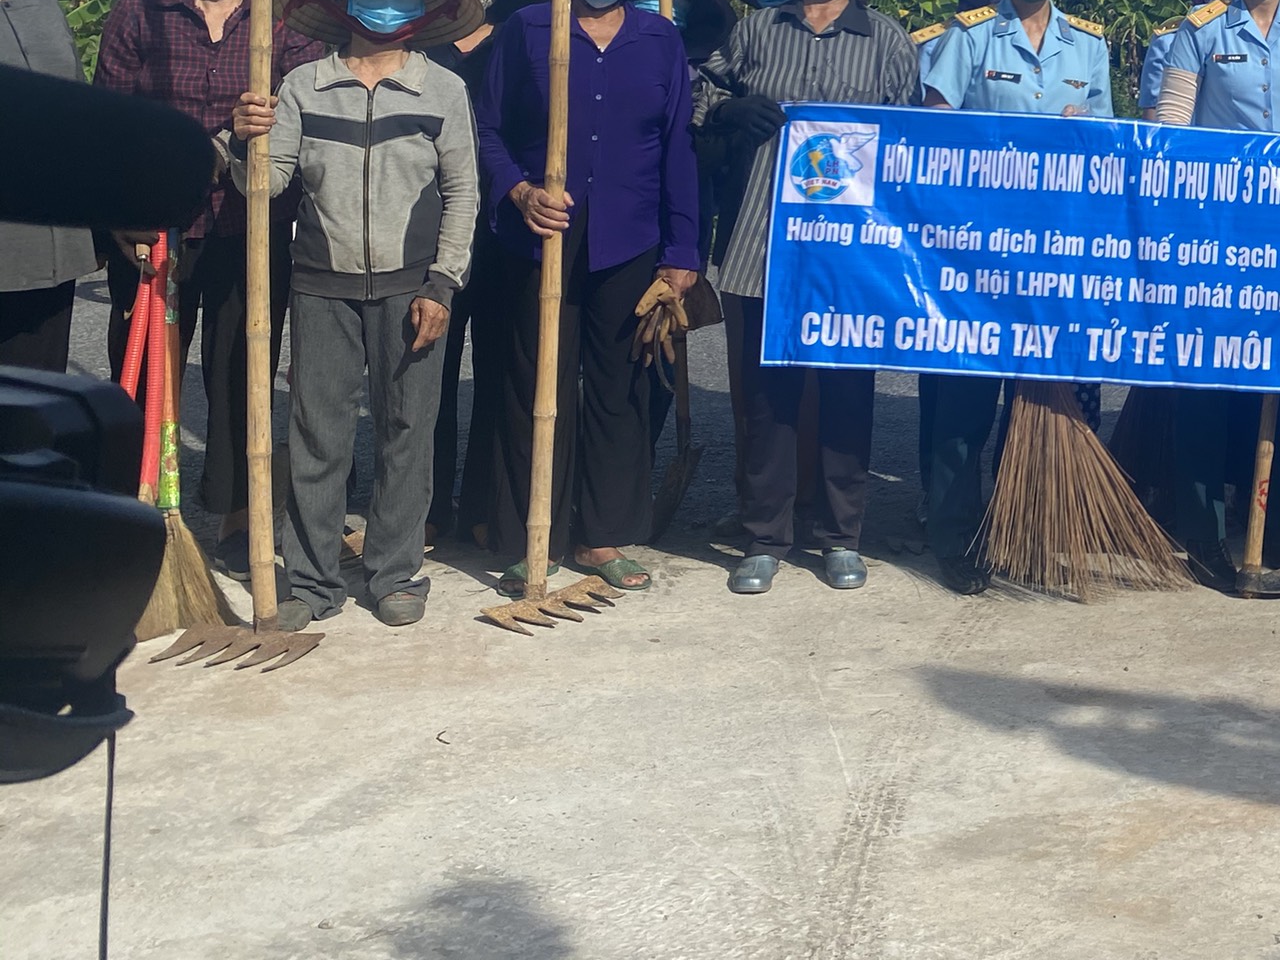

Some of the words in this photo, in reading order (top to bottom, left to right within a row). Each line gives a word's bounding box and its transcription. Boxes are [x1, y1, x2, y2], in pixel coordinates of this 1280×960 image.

[882, 137, 914, 192] HỘI
[916, 146, 965, 187] LHPN
[967, 141, 1039, 191] PHƯỜNG
[1042, 152, 1085, 193] NAM
[1088, 152, 1125, 195] SƠN
[1139, 151, 1170, 206] HỘI
[1173, 161, 1210, 209] PHỤ
[1213, 156, 1241, 203] NỮ
[1242, 165, 1254, 204] 3
[786, 214, 854, 246] Hưởng
[860, 218, 903, 249] ứng
[908, 221, 982, 251] "Chiến
[988, 227, 1036, 259] dịch
[1043, 229, 1085, 257] làm
[1091, 232, 1131, 260] cho
[1138, 233, 1174, 263] thế
[1177, 239, 1219, 267] giới
[1225, 244, 1277, 272] sạch
[939, 266, 969, 292] Do
[975, 268, 1010, 299] Hội
[1016, 270, 1075, 298] LHPN
[1082, 274, 1123, 306] Việt
[1128, 278, 1177, 305] Nam
[1184, 281, 1233, 309] phát
[801, 305, 885, 349] CÙNG
[894, 316, 1001, 356] CHUNG
[1011, 322, 1060, 359] TAY
[1132, 321, 1170, 366] TẾ
[1175, 327, 1204, 368] VÌ
[1213, 330, 1272, 371] MÔI
